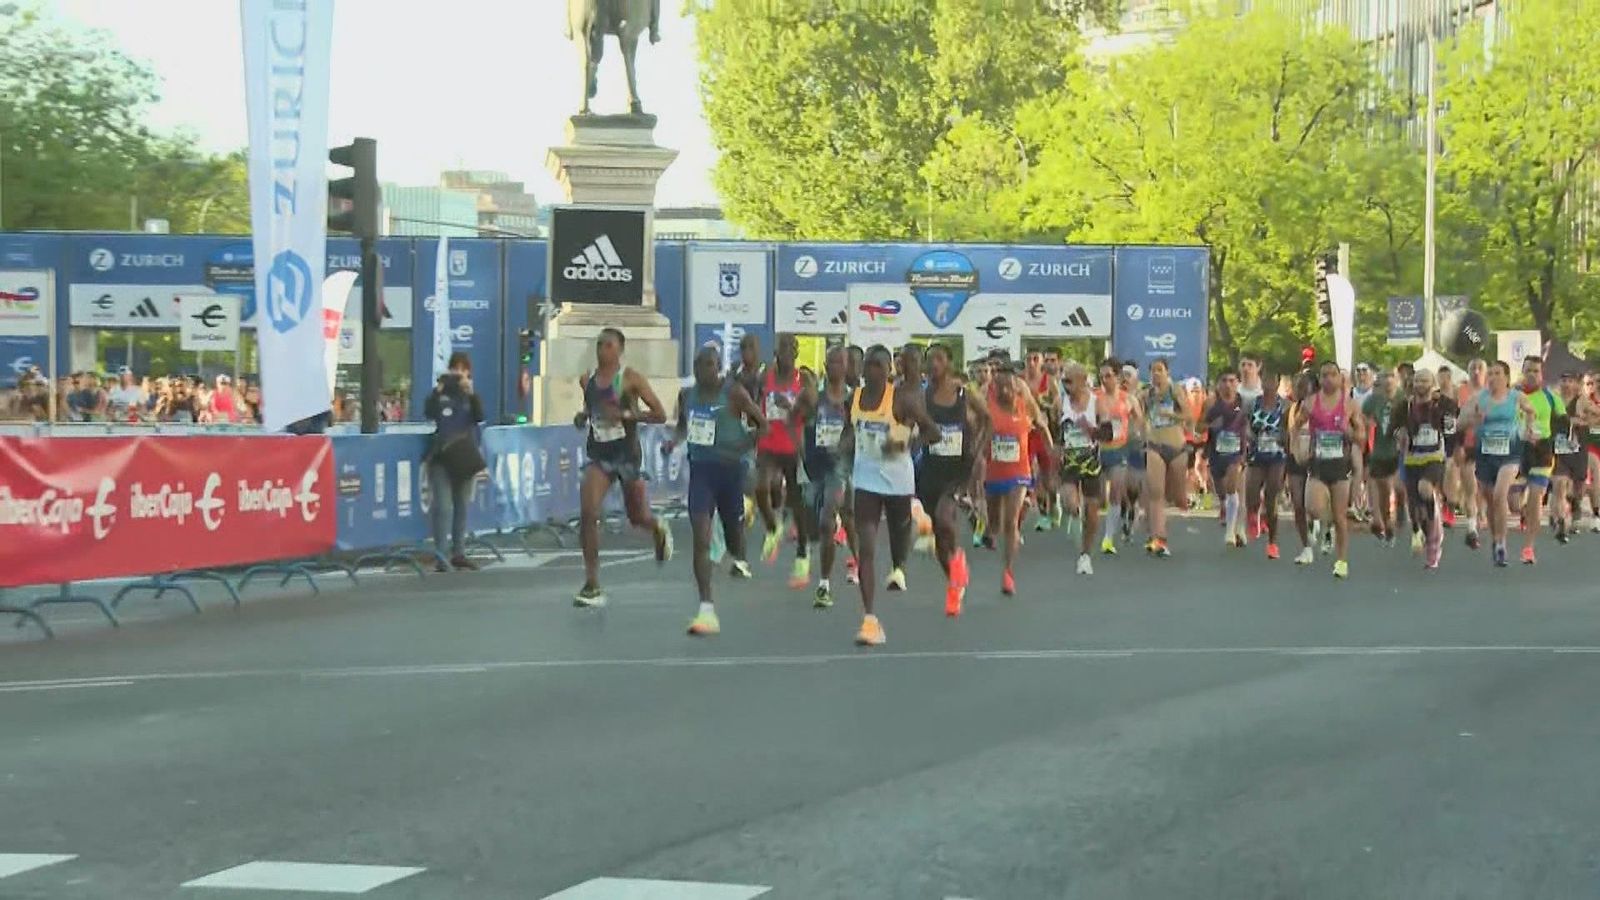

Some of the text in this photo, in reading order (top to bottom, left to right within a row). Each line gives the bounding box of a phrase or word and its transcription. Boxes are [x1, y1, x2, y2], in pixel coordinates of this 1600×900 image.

[120, 253, 185, 267] ZURICH
[327, 254, 391, 268] ZURH
[563, 265, 633, 282] adidas
[824, 261, 886, 274] ZURICH
[1028, 262, 1091, 278] ZURICH
[707, 303, 750, 313] MADRID
[1148, 307, 1192, 318] ZURICH
